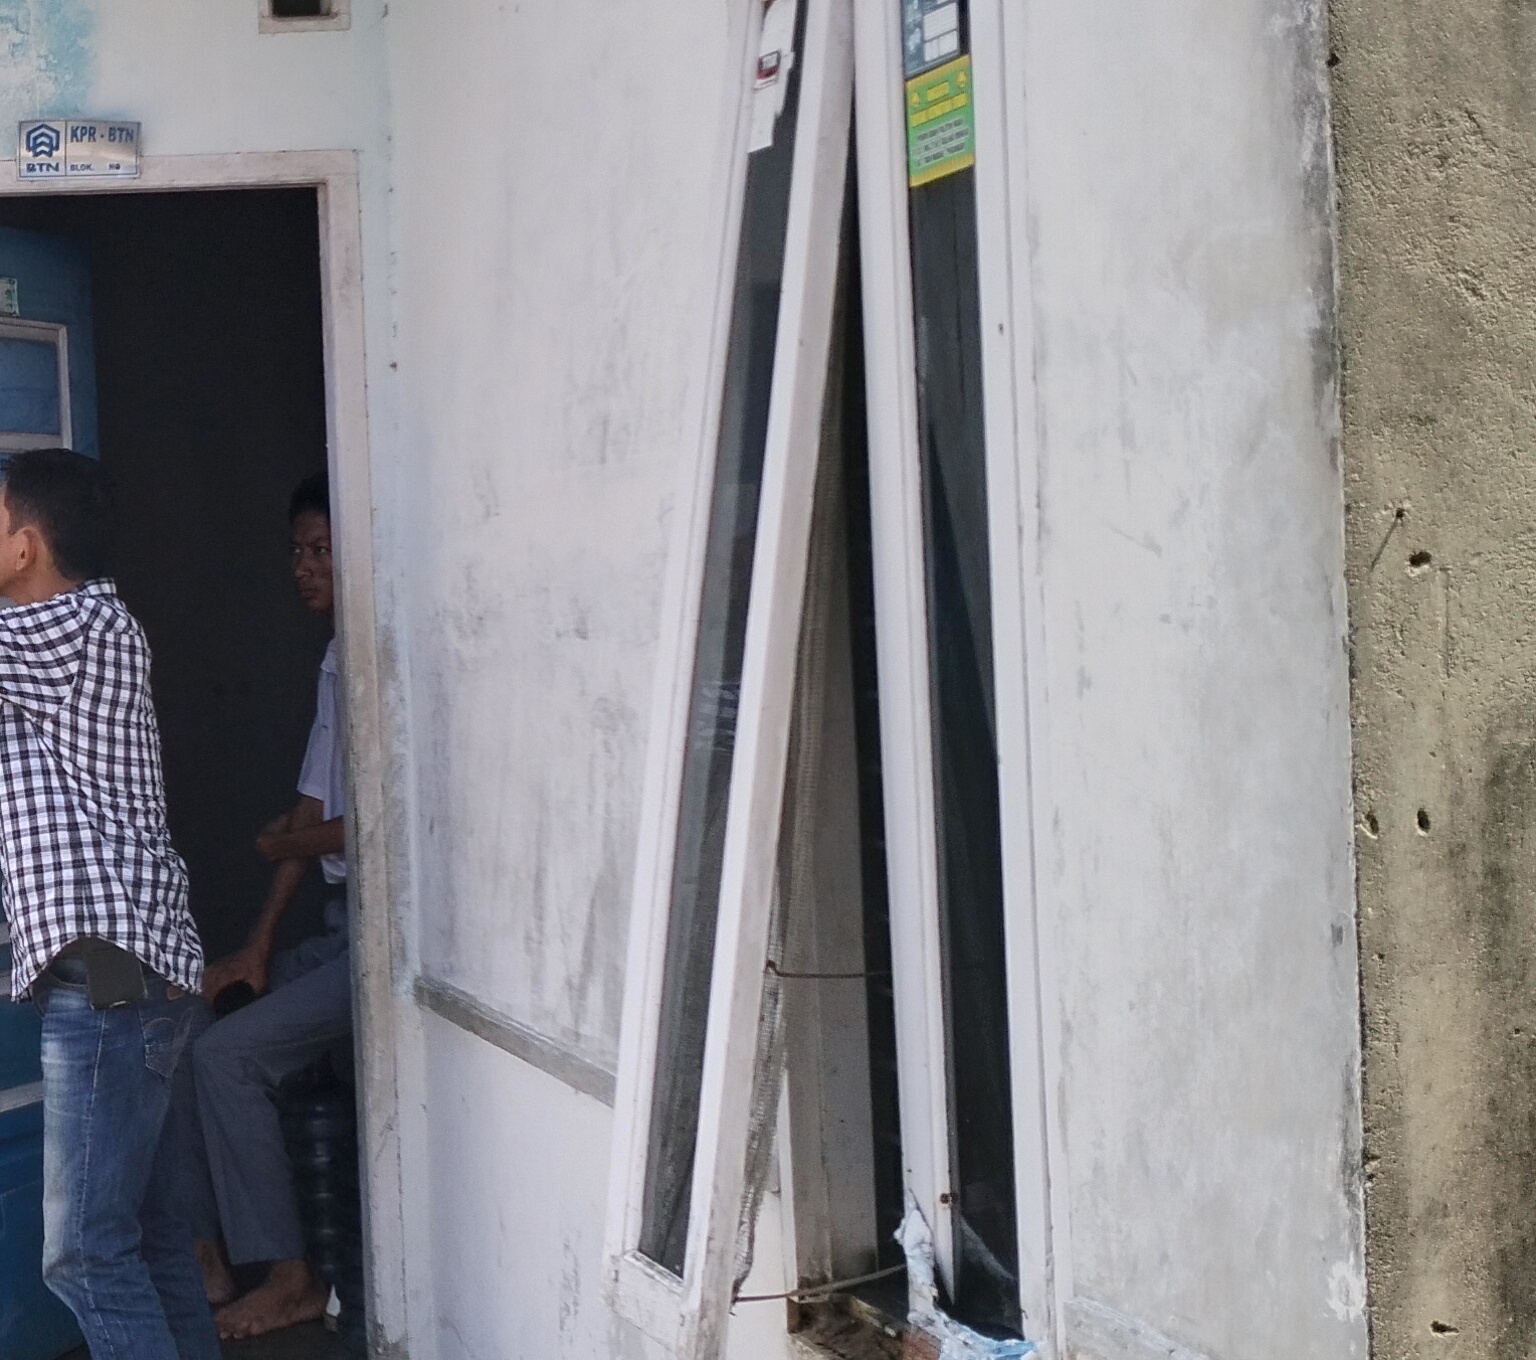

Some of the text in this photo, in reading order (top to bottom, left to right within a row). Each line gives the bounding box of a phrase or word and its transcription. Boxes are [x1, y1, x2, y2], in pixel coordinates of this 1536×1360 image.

[70, 126, 96, 143] KPR
[108, 127, 134, 143] BTN
[26, 162, 59, 172] BTN
